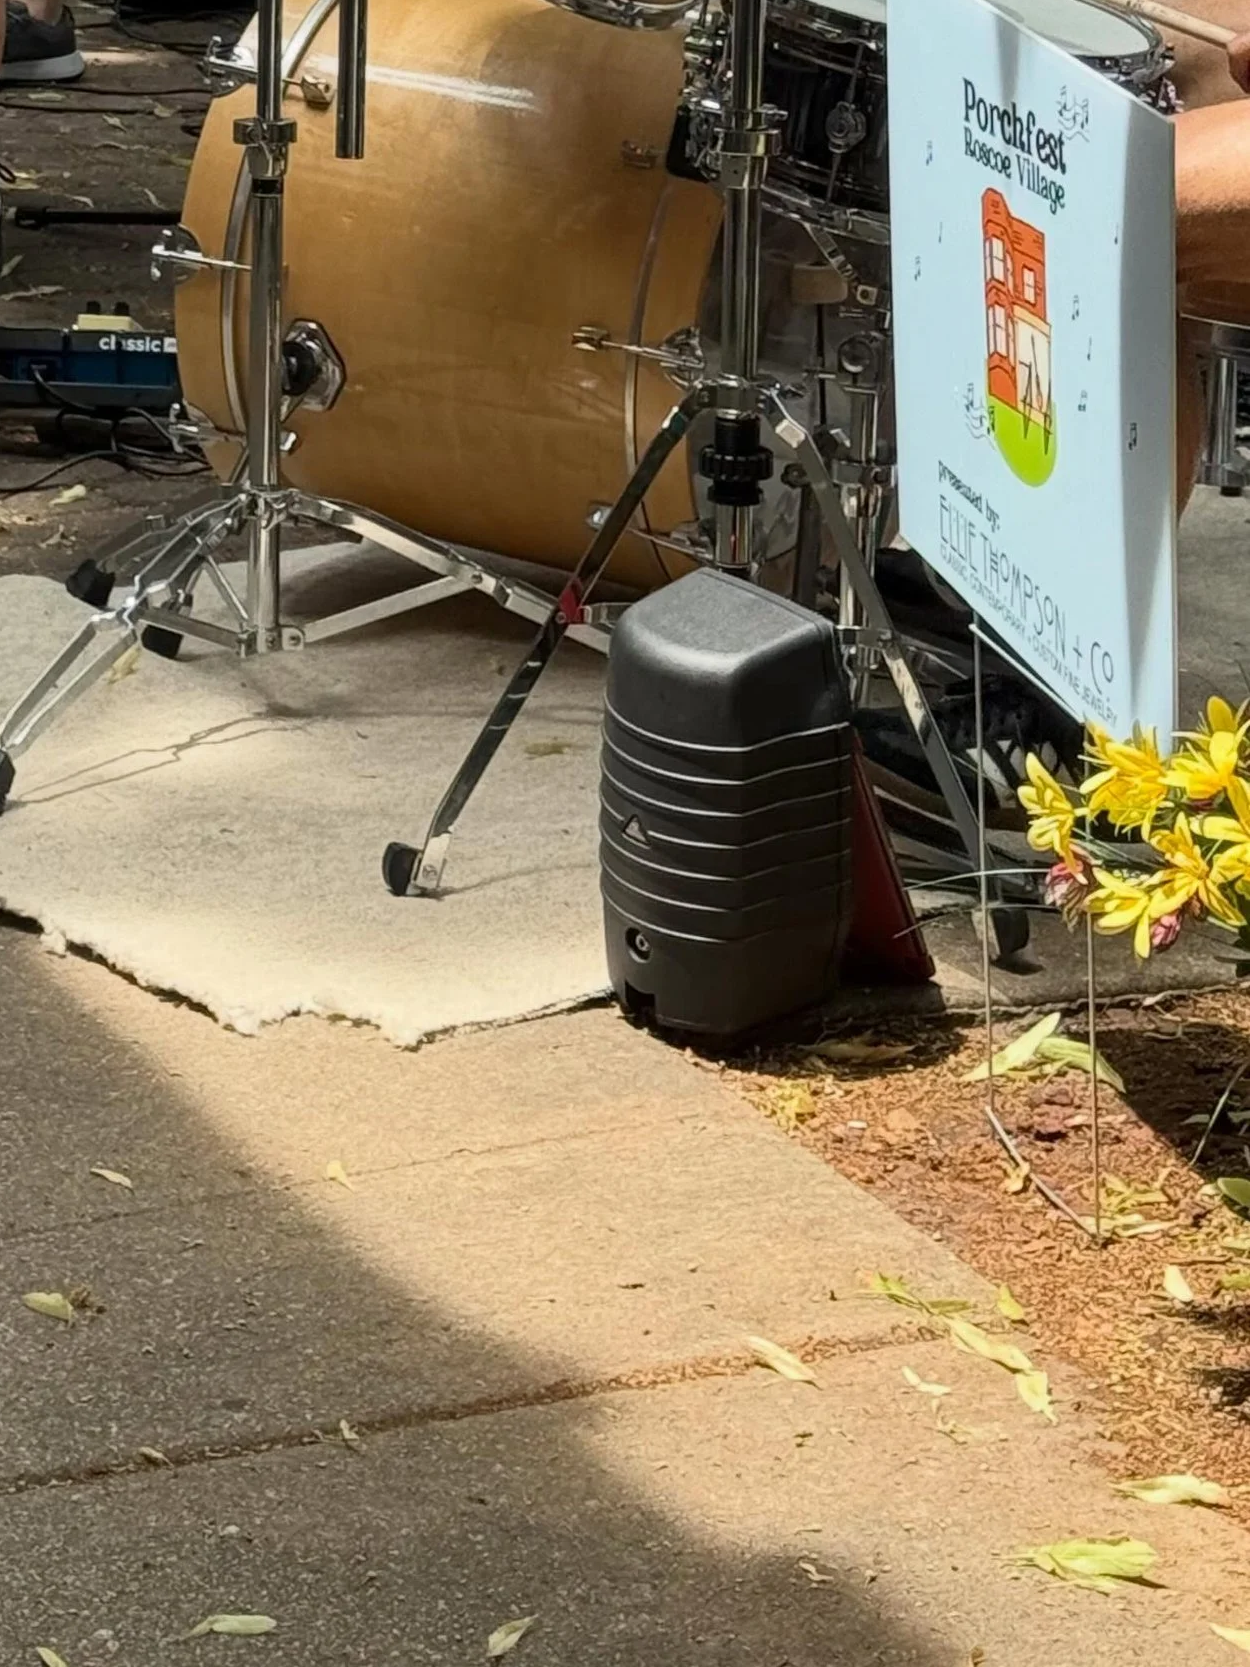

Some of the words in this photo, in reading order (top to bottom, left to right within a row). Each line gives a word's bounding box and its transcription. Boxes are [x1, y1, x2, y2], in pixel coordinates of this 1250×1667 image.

[962, 77, 1066, 175] Porchfest
[963, 126, 1011, 179] Roscoe
[1015, 154, 1065, 215] Village
[938, 460, 983, 514] presented
[986, 498, 1000, 533] by:
[980, 531, 1066, 661] THOMPSON
